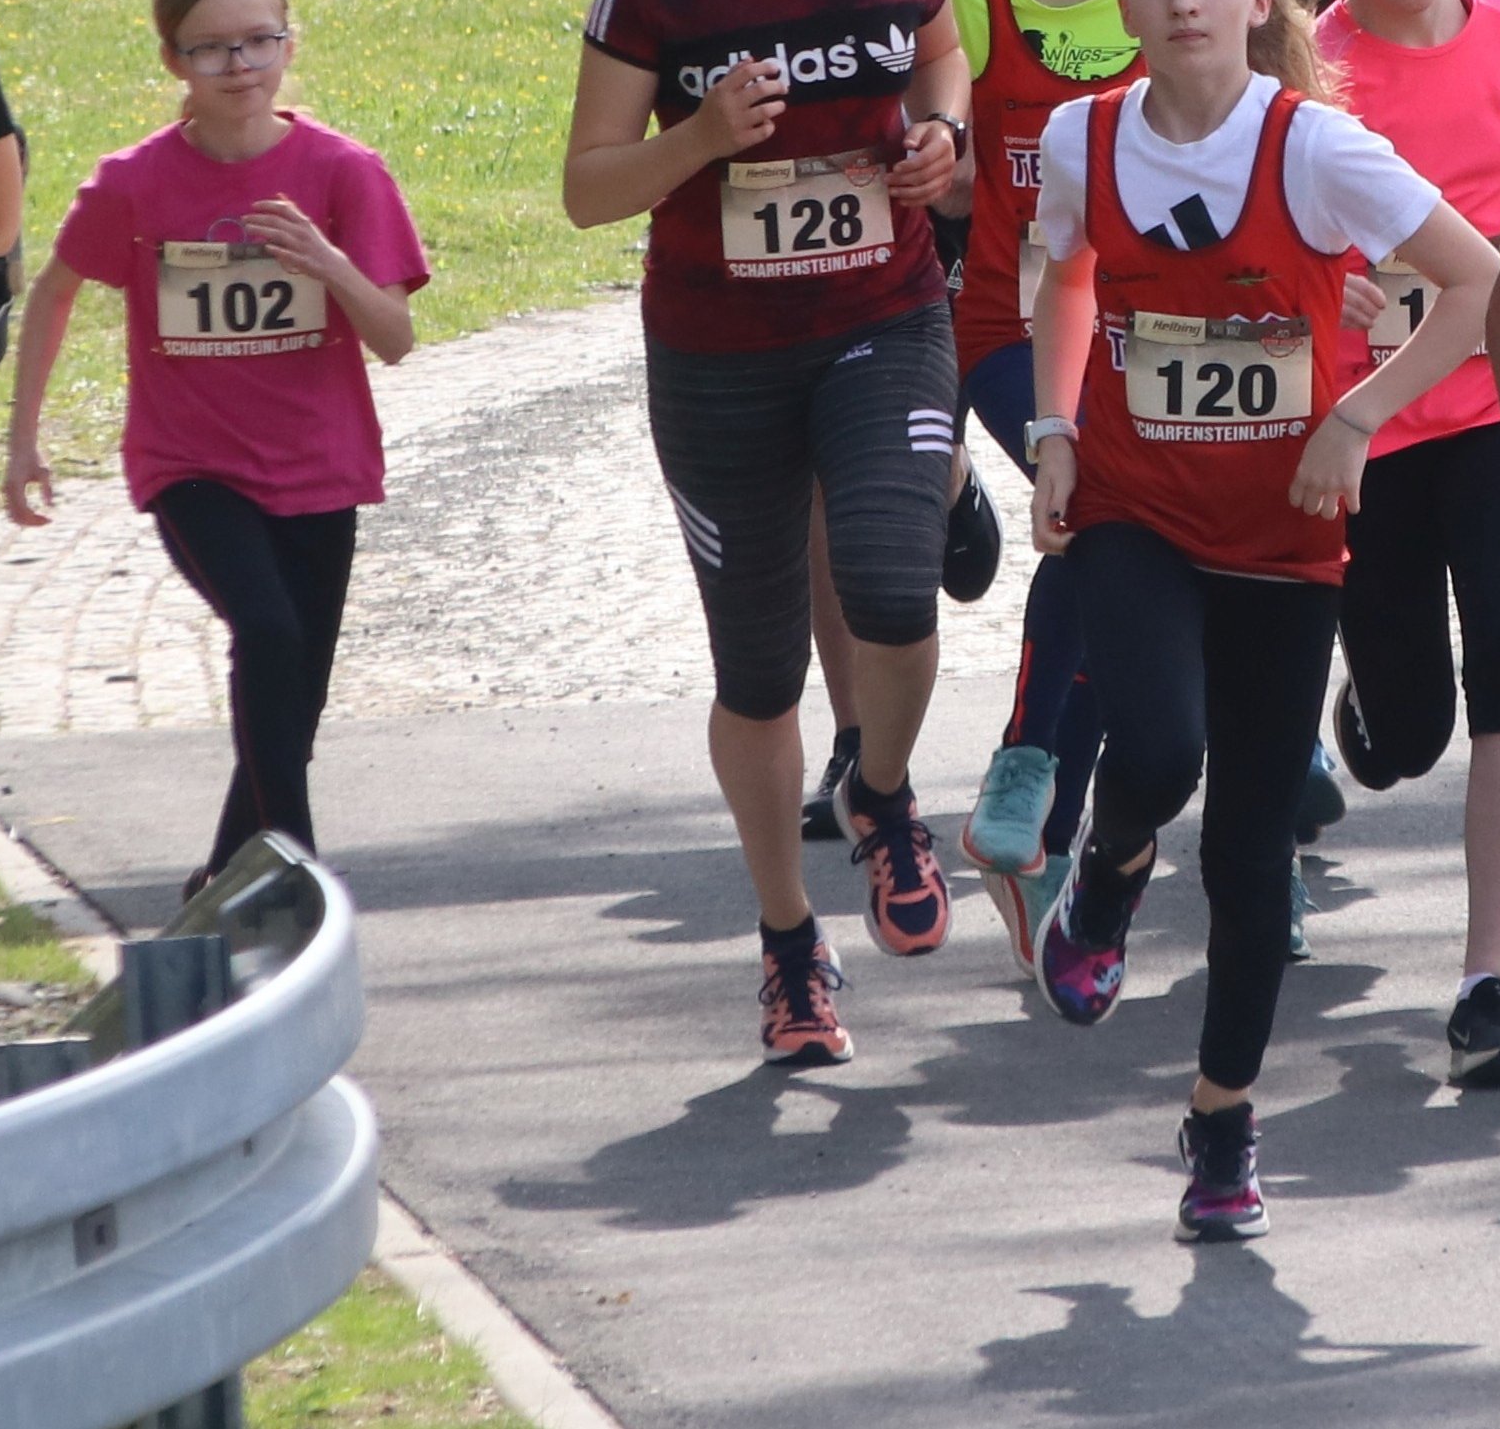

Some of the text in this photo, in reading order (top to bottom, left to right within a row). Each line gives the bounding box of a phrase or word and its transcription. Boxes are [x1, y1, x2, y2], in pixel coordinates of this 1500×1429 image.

[678, 43, 859, 98] addas
[754, 194, 863, 254] 128
[728, 249, 874, 278] SCHARFENSTEINLAUF
[187, 280, 294, 332] 102
[1152, 320, 1201, 338] Helbing
[162, 334, 306, 357] SCHARFENSTEINLAUF
[1156, 360, 1278, 417] 120
